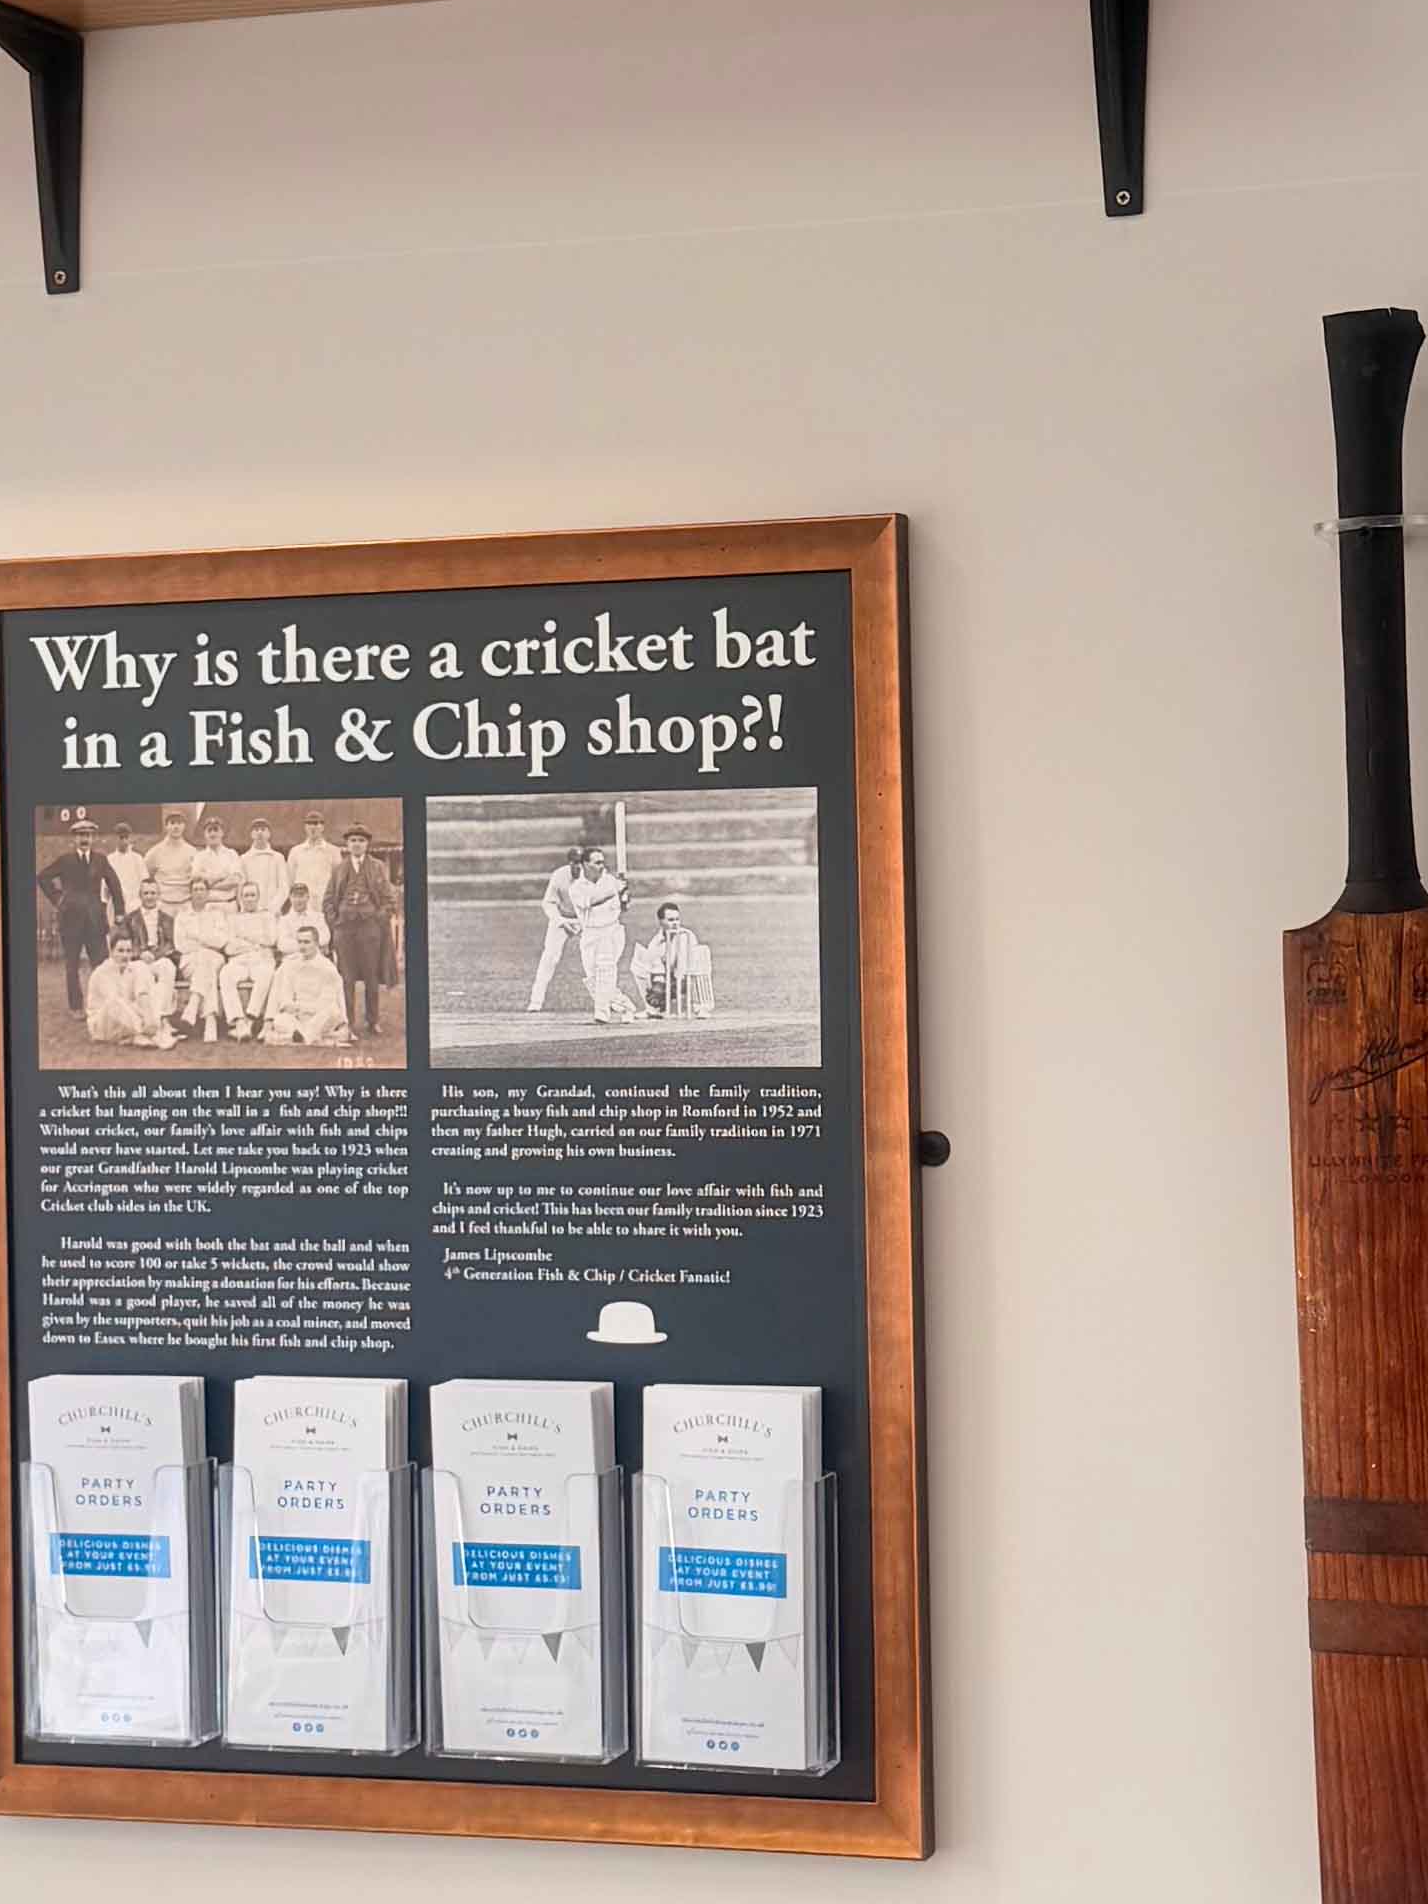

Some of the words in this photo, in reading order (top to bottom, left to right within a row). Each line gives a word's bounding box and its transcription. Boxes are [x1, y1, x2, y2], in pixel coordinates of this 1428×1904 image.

[28, 630, 178, 708] Why
[192, 632, 239, 687] is
[256, 623, 411, 685] there
[429, 642, 464, 679] a
[481, 611, 695, 677] cricket
[712, 606, 817, 669] bat
[61, 716, 122, 769] in
[139, 731, 173, 768] a
[188, 703, 314, 766] Fish
[334, 707, 394, 763] &
[412, 698, 566, 778] Chip
[587, 693, 784, 773] shop?!
[442, 1084, 465, 1098] His
[472, 1088, 499, 1099] son,
[507, 1088, 528, 1102] my
[536, 1084, 596, 1099] Grandad,
[604, 1083, 670, 1098] continued
[678, 1084, 701, 1098] the
[709, 1083, 751, 1102] family
[759, 1083, 822, 1099] tradition,
[442, 1247, 482, 1264] James
[483, 1247, 553, 1265] Lipscombe
[463, 1266, 534, 1281] Generation
[537, 1267, 564, 1281] Fish
[567, 1269, 581, 1282] &
[583, 1267, 616, 1286] Chip
[619, 1268, 625, 1283] /
[627, 1268, 677, 1283] Cricket
[679, 1269, 731, 1284] Fanatic!
[58, 1406, 154, 1427] CHURCHILL'S
[263, 1406, 358, 1428] CHURCHILL'S
[461, 1411, 563, 1433] CHURCHILL'S
[673, 1414, 773, 1439] CHURCHILL'S
[81, 1477, 135, 1489] PARTY
[284, 1480, 337, 1492] PARTY
[75, 1494, 142, 1506] ORDERS
[487, 1486, 542, 1499] PARTY
[695, 1489, 751, 1503] PARTY
[277, 1496, 345, 1510] ORDERS
[480, 1503, 551, 1516] ORDERS
[688, 1506, 759, 1522] ORDERS
[696, 1568, 727, 1577] YOUR
[732, 1569, 771, 1579] EVENT
